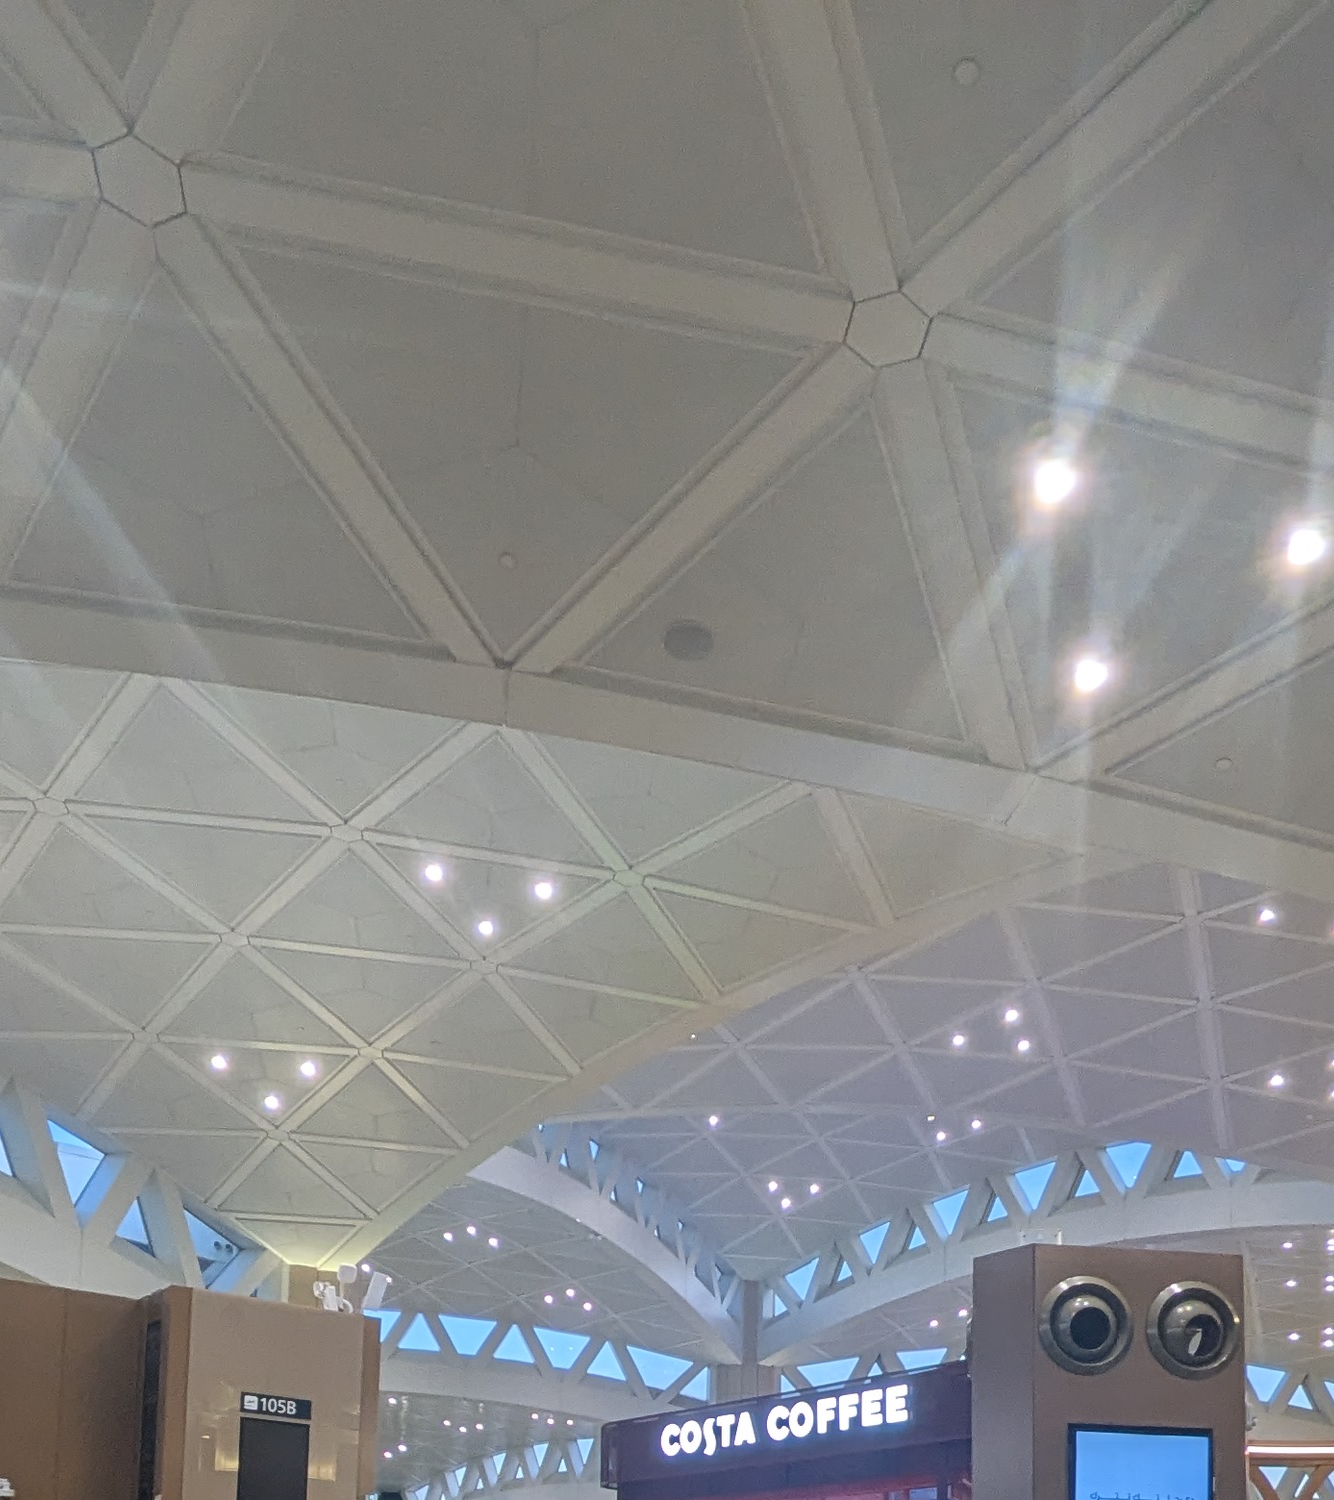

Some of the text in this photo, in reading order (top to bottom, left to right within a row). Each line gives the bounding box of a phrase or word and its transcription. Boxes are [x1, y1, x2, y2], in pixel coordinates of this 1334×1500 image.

[260, 1397, 297, 1415] 105B
[660, 1384, 909, 1456] COSTA COFFEE
